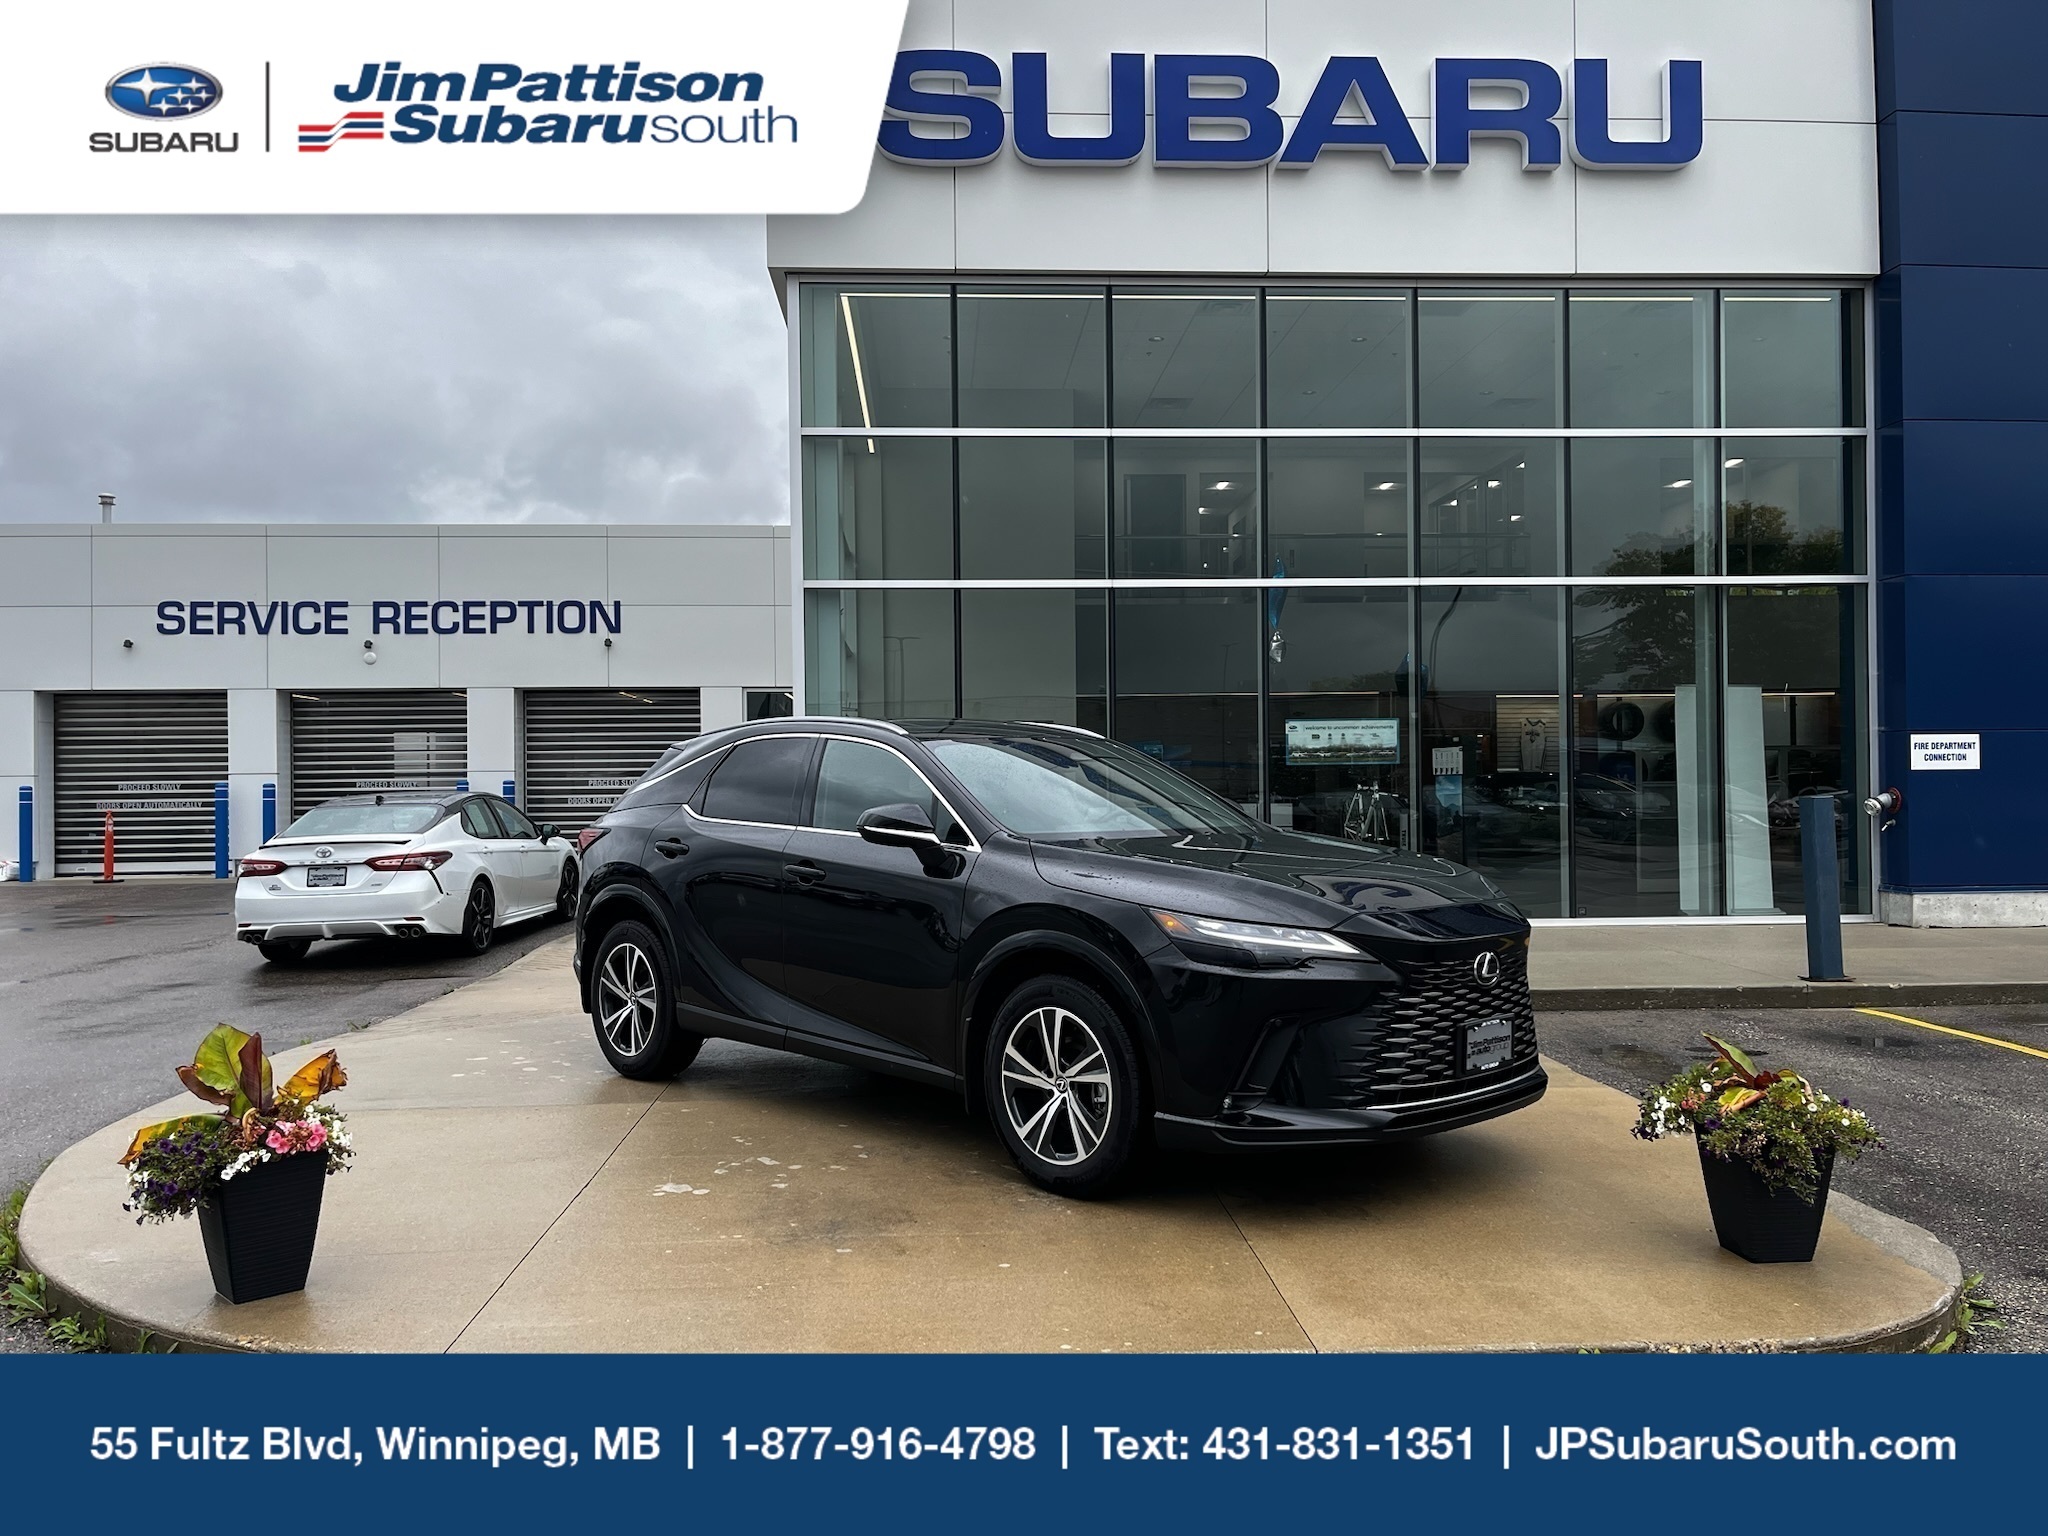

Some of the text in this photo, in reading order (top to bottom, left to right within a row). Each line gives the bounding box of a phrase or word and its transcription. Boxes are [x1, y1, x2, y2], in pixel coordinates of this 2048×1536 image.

[875, 48, 1704, 172] SUBARU
[156, 599, 622, 636] SERVICE RECEPTION
[1914, 742, 1976, 750] FIRE DEPARTMENT
[1924, 753, 1967, 761] CONNECTION
[144, 801, 203, 809] AUTOMATICALLY
